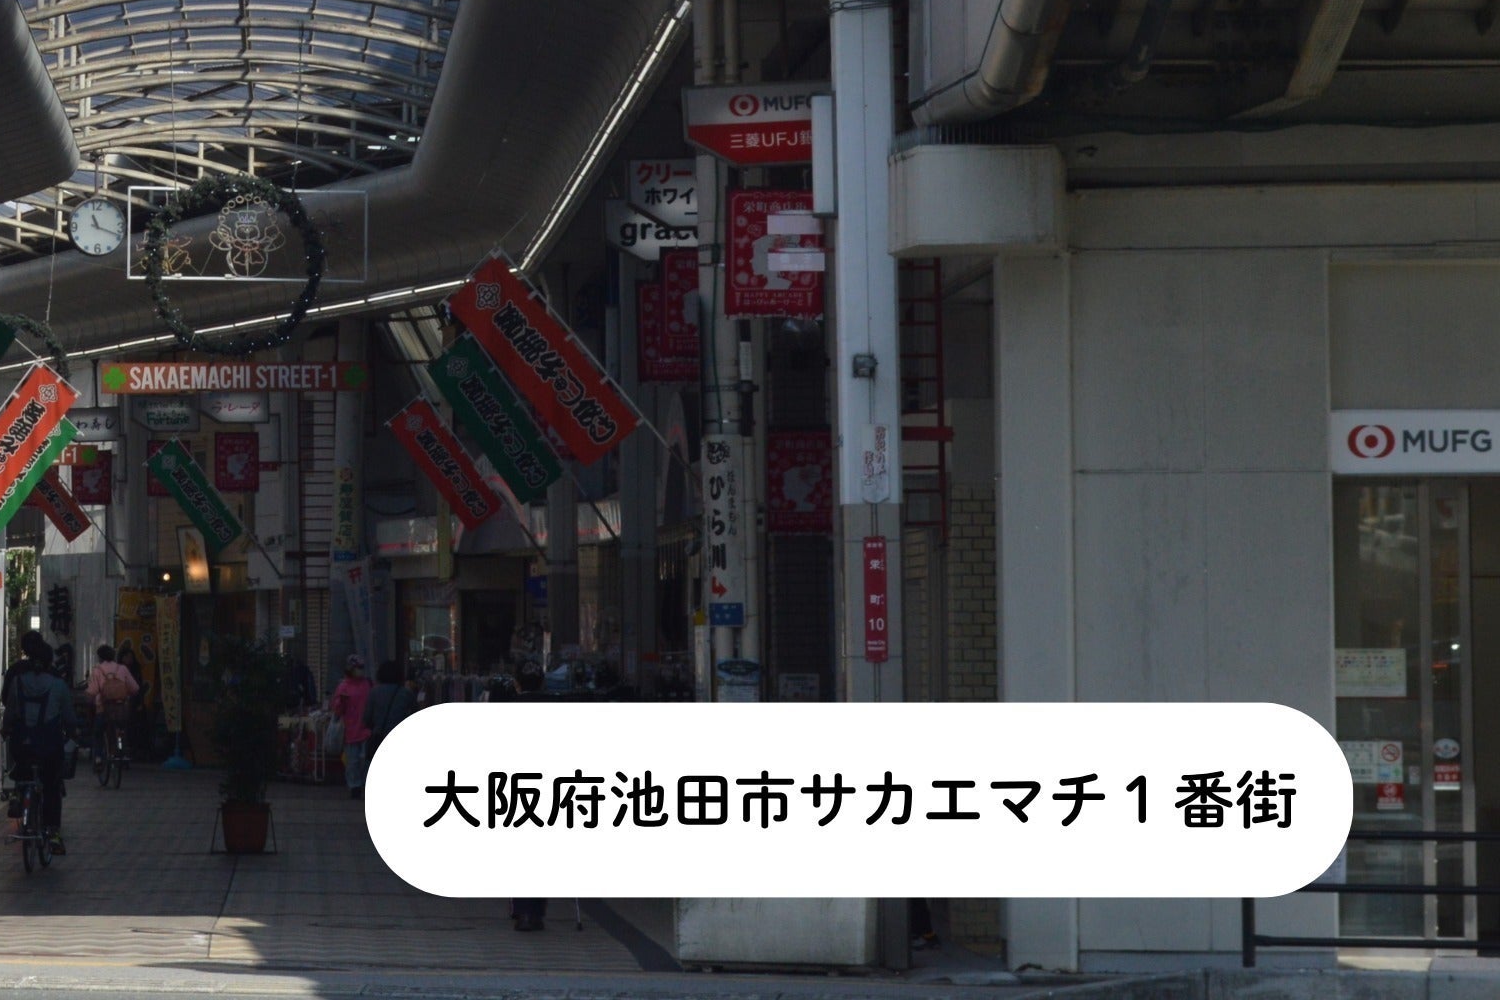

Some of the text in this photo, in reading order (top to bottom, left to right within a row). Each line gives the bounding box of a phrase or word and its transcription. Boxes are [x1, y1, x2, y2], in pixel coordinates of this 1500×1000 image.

[636, 162, 693, 185] クリー
[644, 186, 695, 206] ホワイ
[91, 201, 104, 212] 12
[70, 222, 125, 232] 9 3
[93, 243, 102, 254] 6
[129, 364, 338, 391] SAKAEMACHI STREET-1
[1402, 429, 1493, 453] MUFG
[709, 475, 728, 571] ひら川
[867, 617, 885, 632] 10
